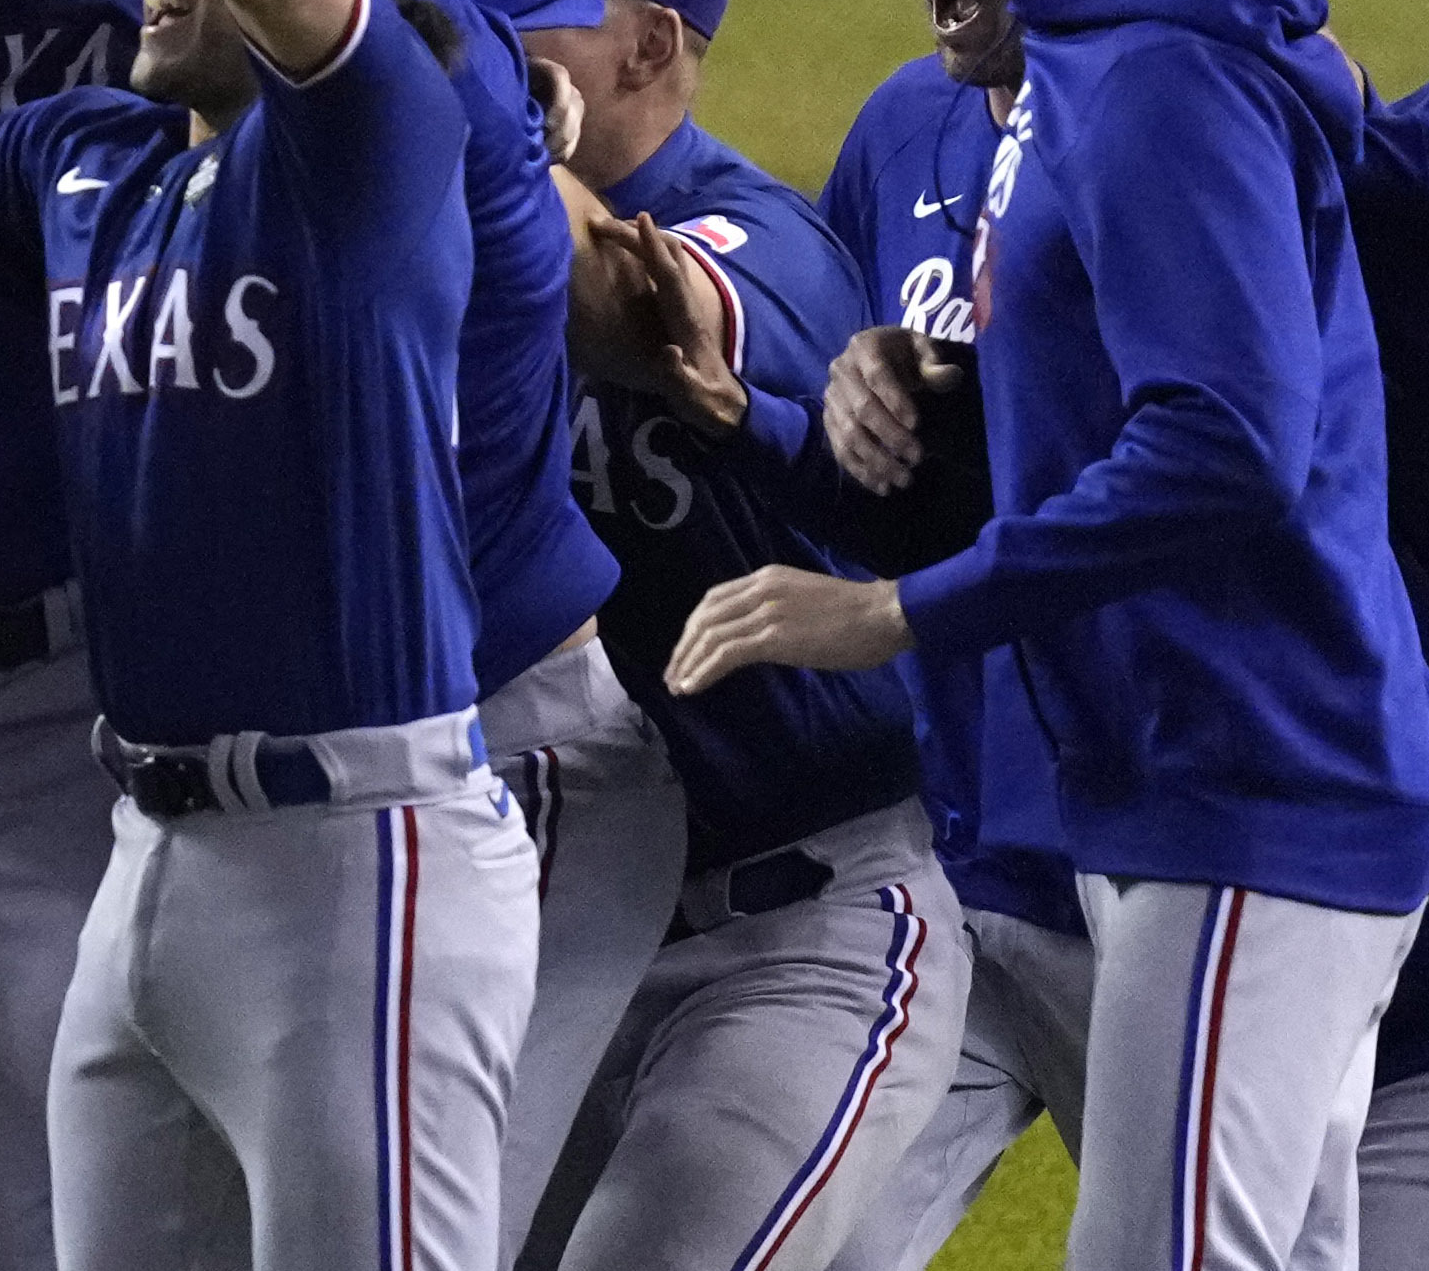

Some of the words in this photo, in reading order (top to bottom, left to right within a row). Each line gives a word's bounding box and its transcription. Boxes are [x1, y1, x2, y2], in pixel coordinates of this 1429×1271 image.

[46, 266, 279, 408] EXAS
[899, 256, 977, 345] Ra
[569, 394, 695, 530] AS
